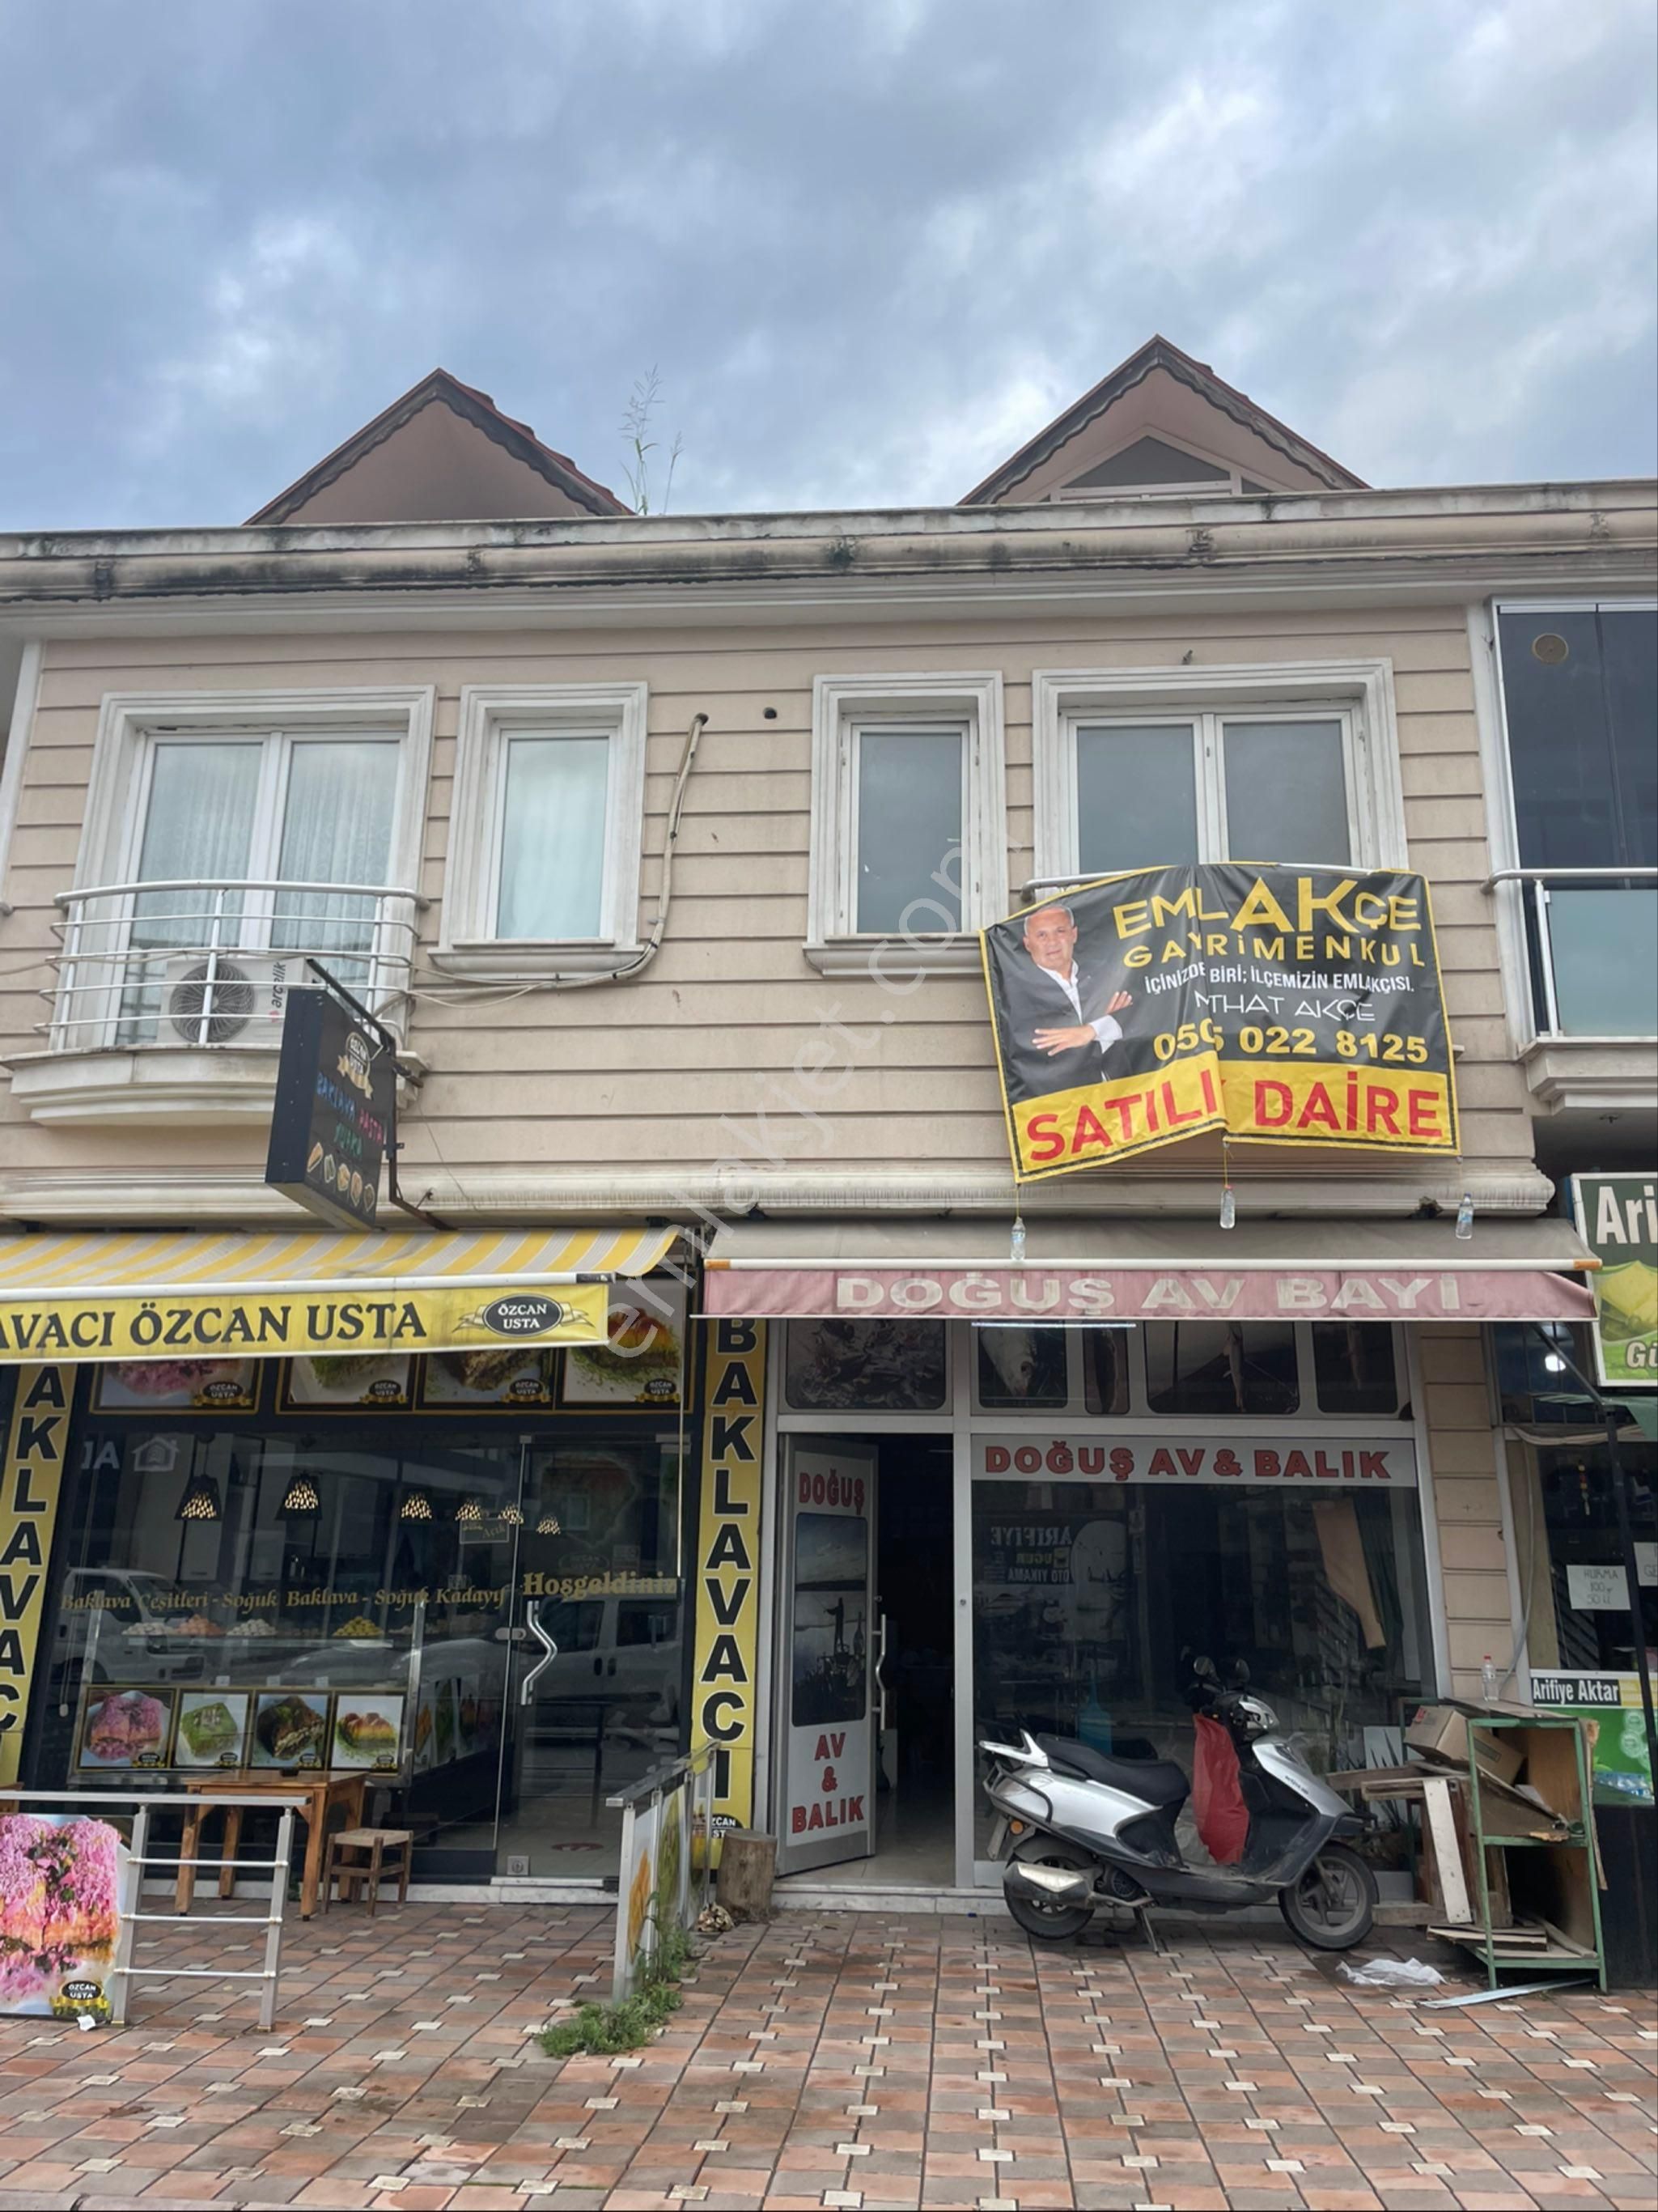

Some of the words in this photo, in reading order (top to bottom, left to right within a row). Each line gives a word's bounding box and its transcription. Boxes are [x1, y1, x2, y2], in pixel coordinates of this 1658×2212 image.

[1113, 877, 1422, 940] EMLAKÇE
[1123, 932, 1425, 968] GAYRİMENKUL
[1251, 967, 1329, 990] İLÇEMİZİN
[1239, 1026, 1317, 1055] 022
[1336, 1030, 1429, 1064] 8125
[1027, 1068, 1226, 1161] SATILI
[1253, 1071, 1443, 1138] DAİRE
[498, 1304, 548, 1316] ÖZCAN
[837, 1272, 1115, 1315] DOĞUŞ
[1141, 1278, 1245, 1309] AV
[1276, 1273, 1460, 1310] BAYİ
[130, 1301, 290, 1346] ÖZCAN
[307, 1302, 427, 1340] USTA
[503, 1318, 541, 1329] USTA
[985, 1440, 1135, 1481] DOĞUŞ
[1148, 1448, 1206, 1476] AV
[1214, 1448, 1245, 1478] &
[1253, 1450, 1392, 1479] BALIK
[798, 1468, 865, 1515] DOĞUŞ
[701, 1318, 757, 1800] BAKLAVACI
[61, 1589, 131, 1610] Baklava
[221, 1589, 278, 1614] Soğuk
[286, 1587, 358, 1607] Baklava
[374, 1586, 430, 1611] Soğuk
[1533, 1679, 1574, 1705] Arifiye
[1578, 1679, 1619, 1702] Aktar
[814, 1732, 846, 1761] AV
[821, 1766, 838, 1793] &
[711, 1816, 736, 1827] ZCAN
[791, 1795, 864, 1834] BALIK
[713, 1829, 727, 1838] ST
